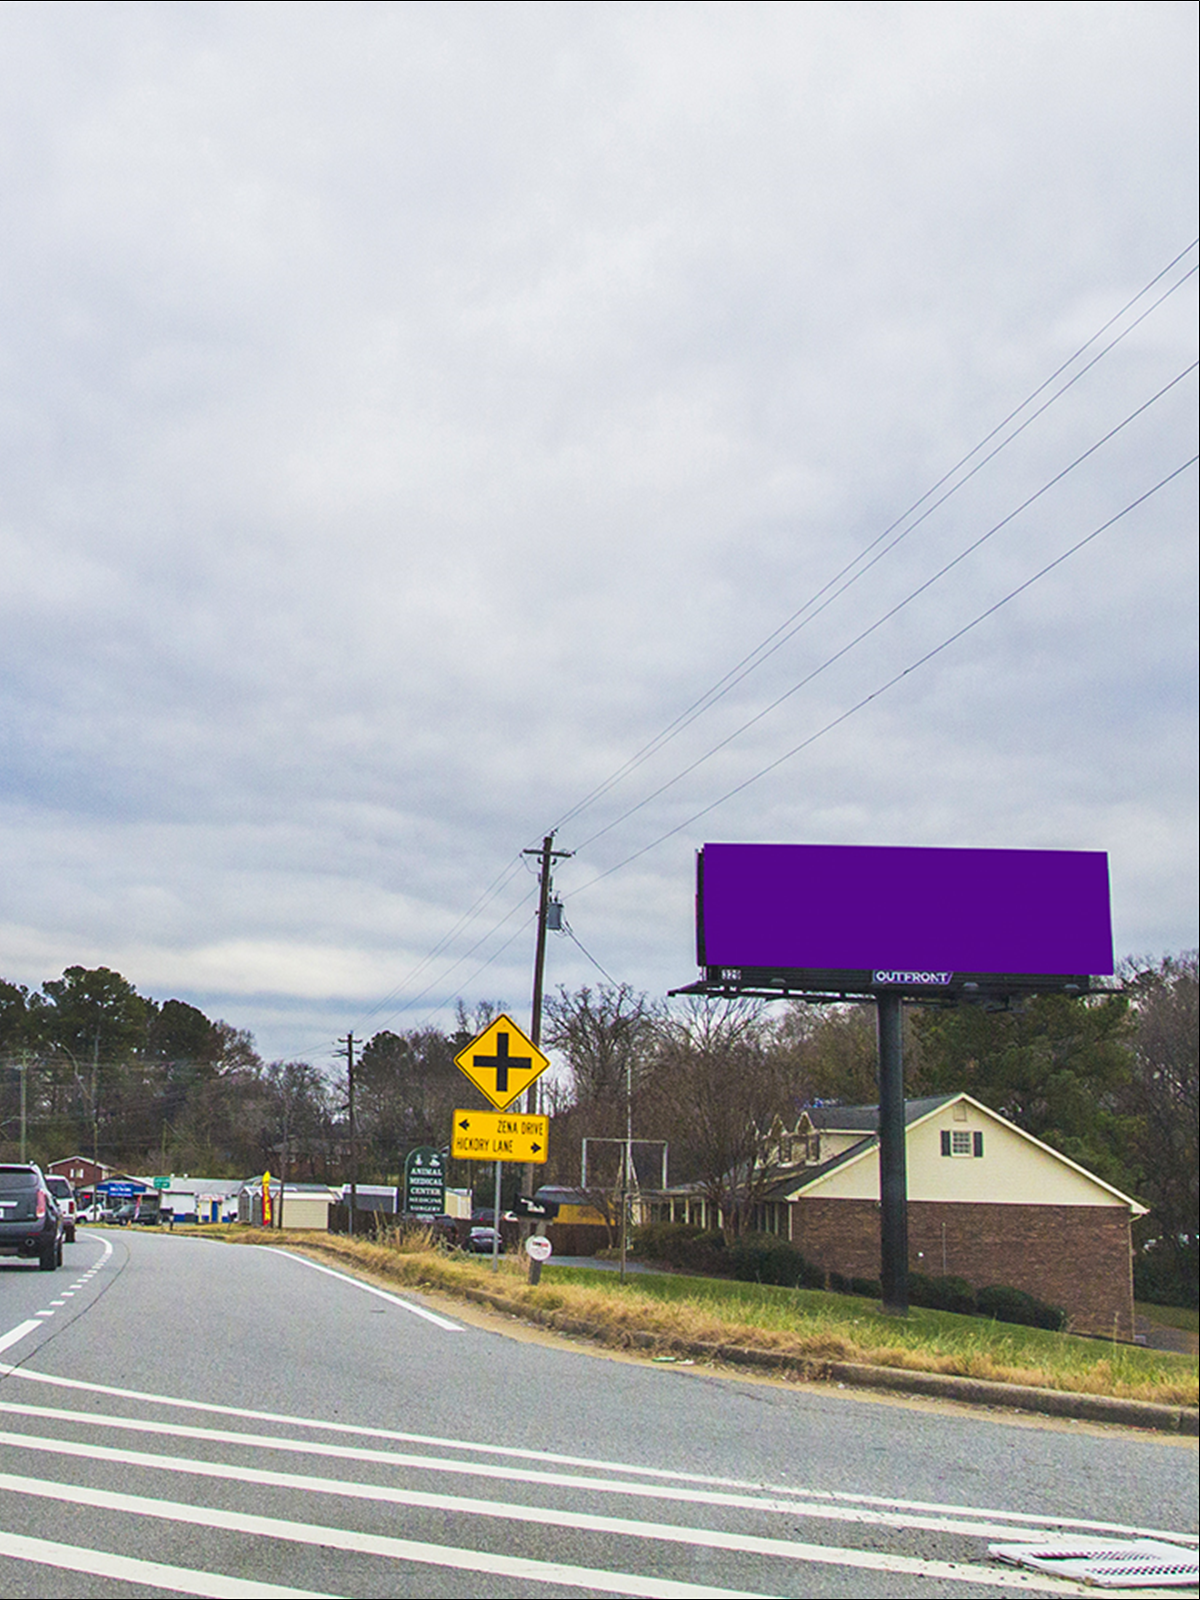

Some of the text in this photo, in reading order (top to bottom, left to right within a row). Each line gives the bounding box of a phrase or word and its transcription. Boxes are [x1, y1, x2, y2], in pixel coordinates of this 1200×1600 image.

[875, 970, 950, 983] OUTFRONT
[497, 1119, 543, 1136] ZENA DRIVE
[456, 1137, 513, 1153] HICKORY LANE
[411, 1167, 442, 1176] ANIMAL
[409, 1177, 443, 1186] MEDICAL
[410, 1187, 441, 1196] CENTER
